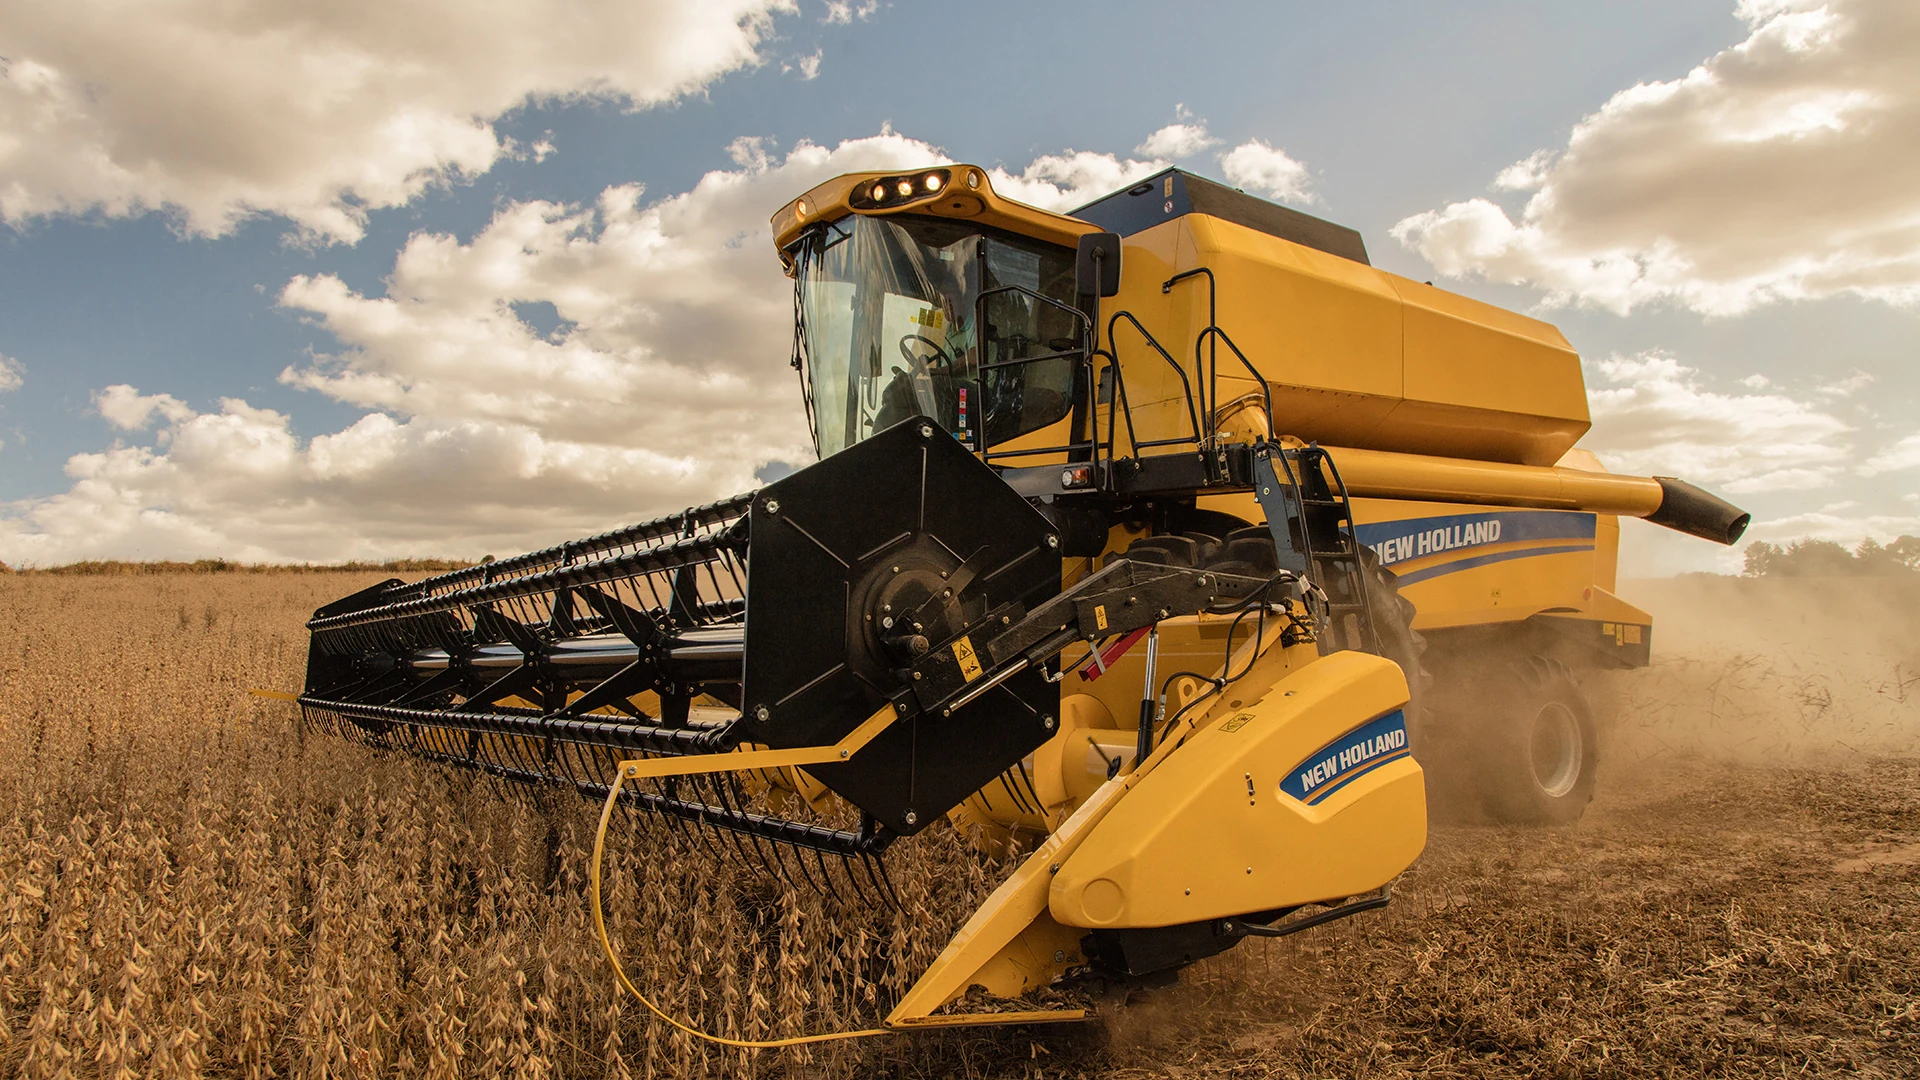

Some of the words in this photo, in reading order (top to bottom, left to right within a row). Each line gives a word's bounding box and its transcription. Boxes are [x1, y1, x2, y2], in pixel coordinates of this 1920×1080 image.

[1417, 519, 1501, 556] HOLLAND
[1301, 755, 1338, 792] NEW
[1339, 729, 1405, 771] HOLLAND
